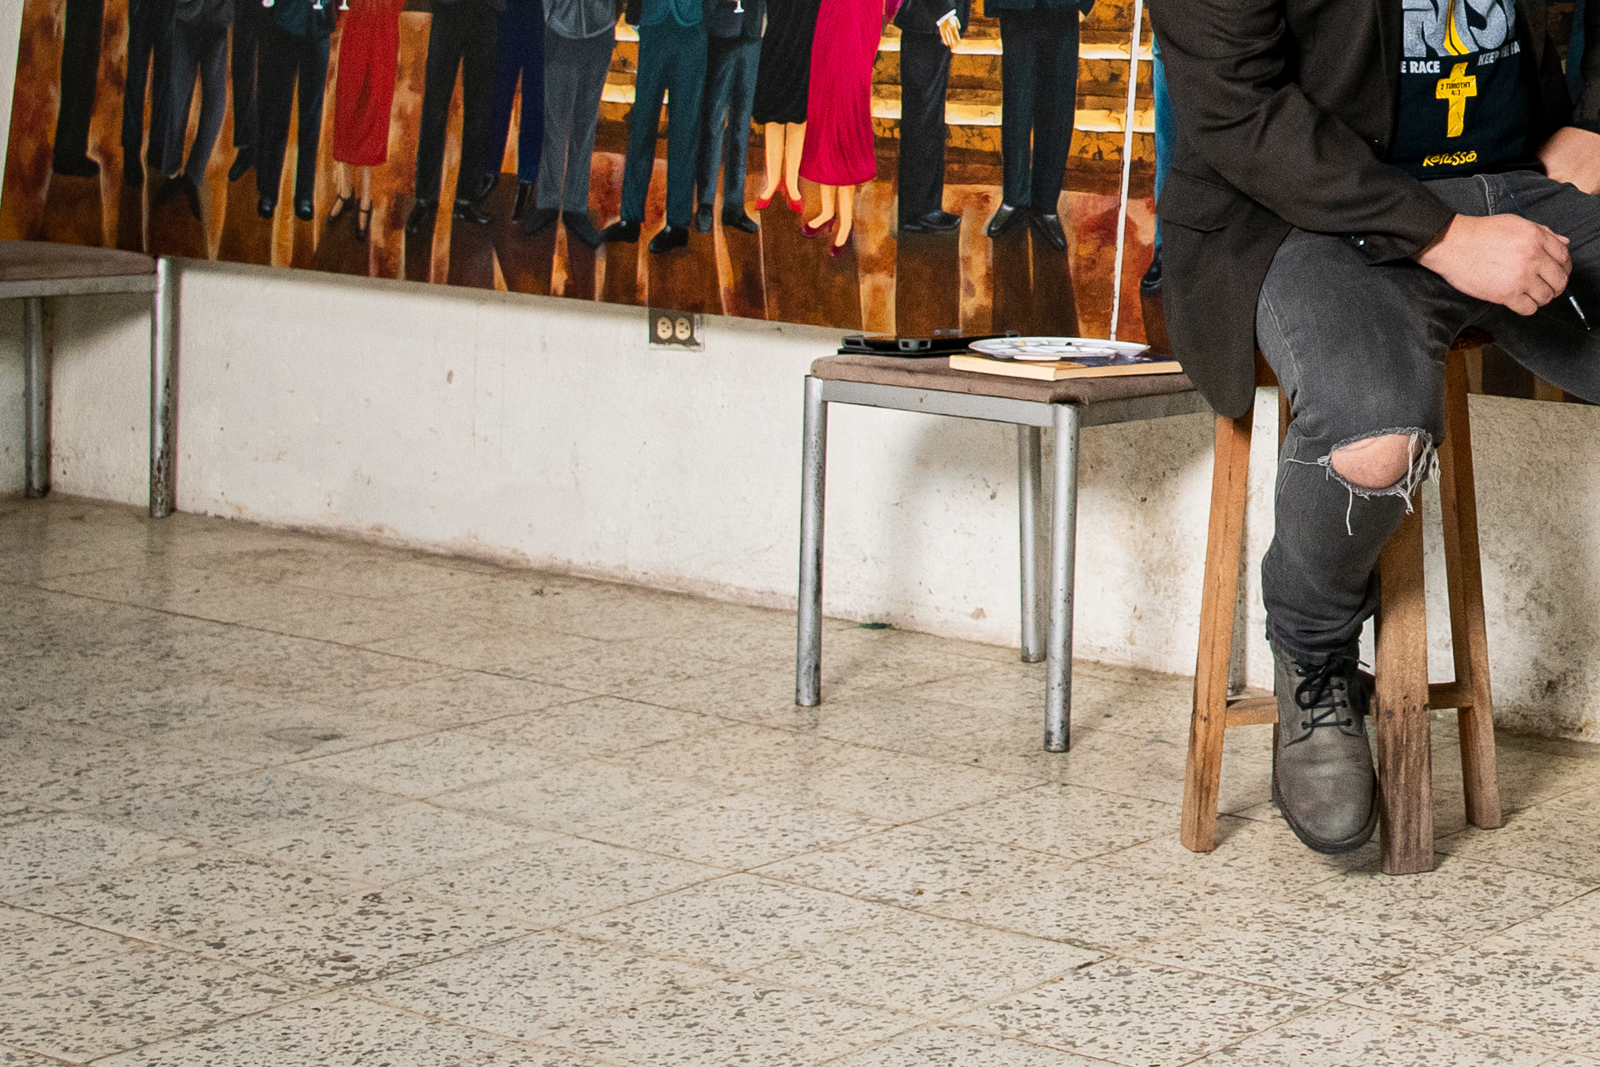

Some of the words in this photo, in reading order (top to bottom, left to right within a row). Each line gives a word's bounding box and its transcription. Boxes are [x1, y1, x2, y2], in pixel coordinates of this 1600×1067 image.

[1477, 50, 1500, 66] KEEP
[1409, 60, 1441, 74] RACE
[1446, 81, 1471, 90] TIMOTHY
